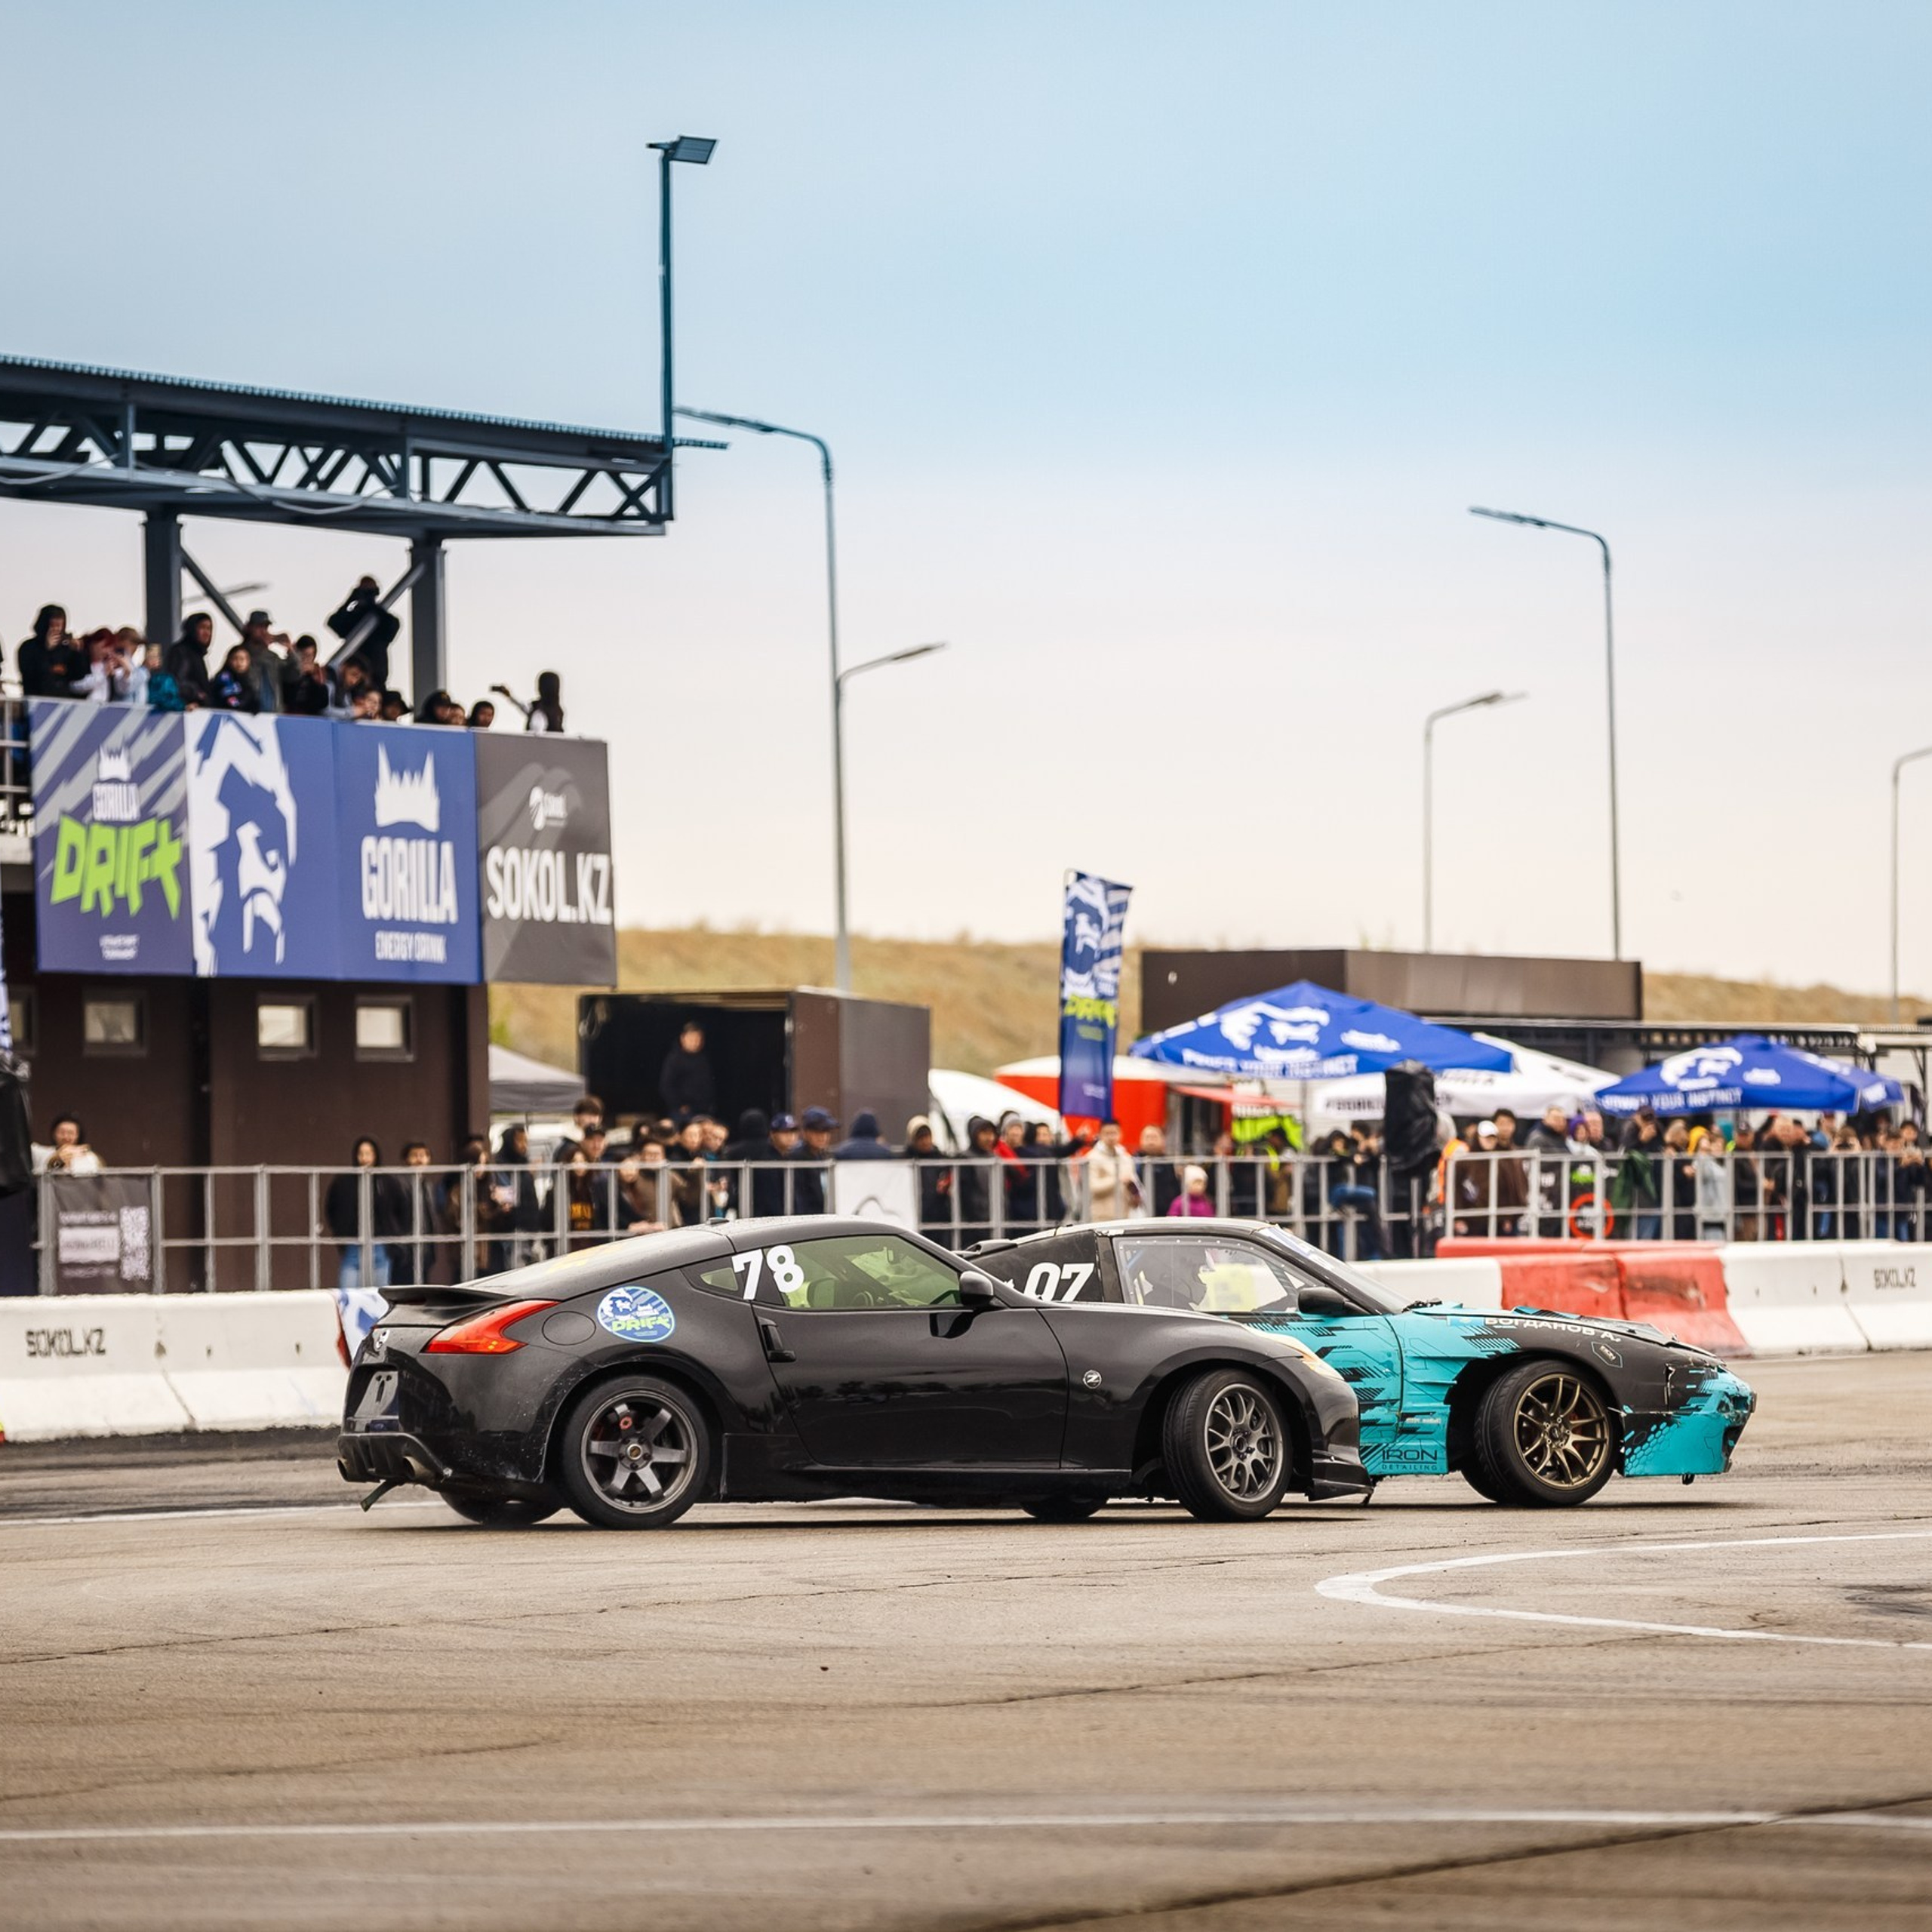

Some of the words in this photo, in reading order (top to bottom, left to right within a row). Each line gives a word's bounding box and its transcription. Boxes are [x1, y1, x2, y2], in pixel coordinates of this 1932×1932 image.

[51, 814, 182, 920] DRIFT
[361, 835, 458, 924] GORILLA
[486, 845, 613, 925] SOKOL.KZ
[376, 931, 414, 961] ENERGY
[414, 932, 447, 964] DRINK
[731, 1245, 804, 1300] 78
[1023, 1262, 1095, 1302] 07
[1484, 1317, 1595, 1336] БОГДАНОВ
[1382, 1450, 1438, 1461] IRON
